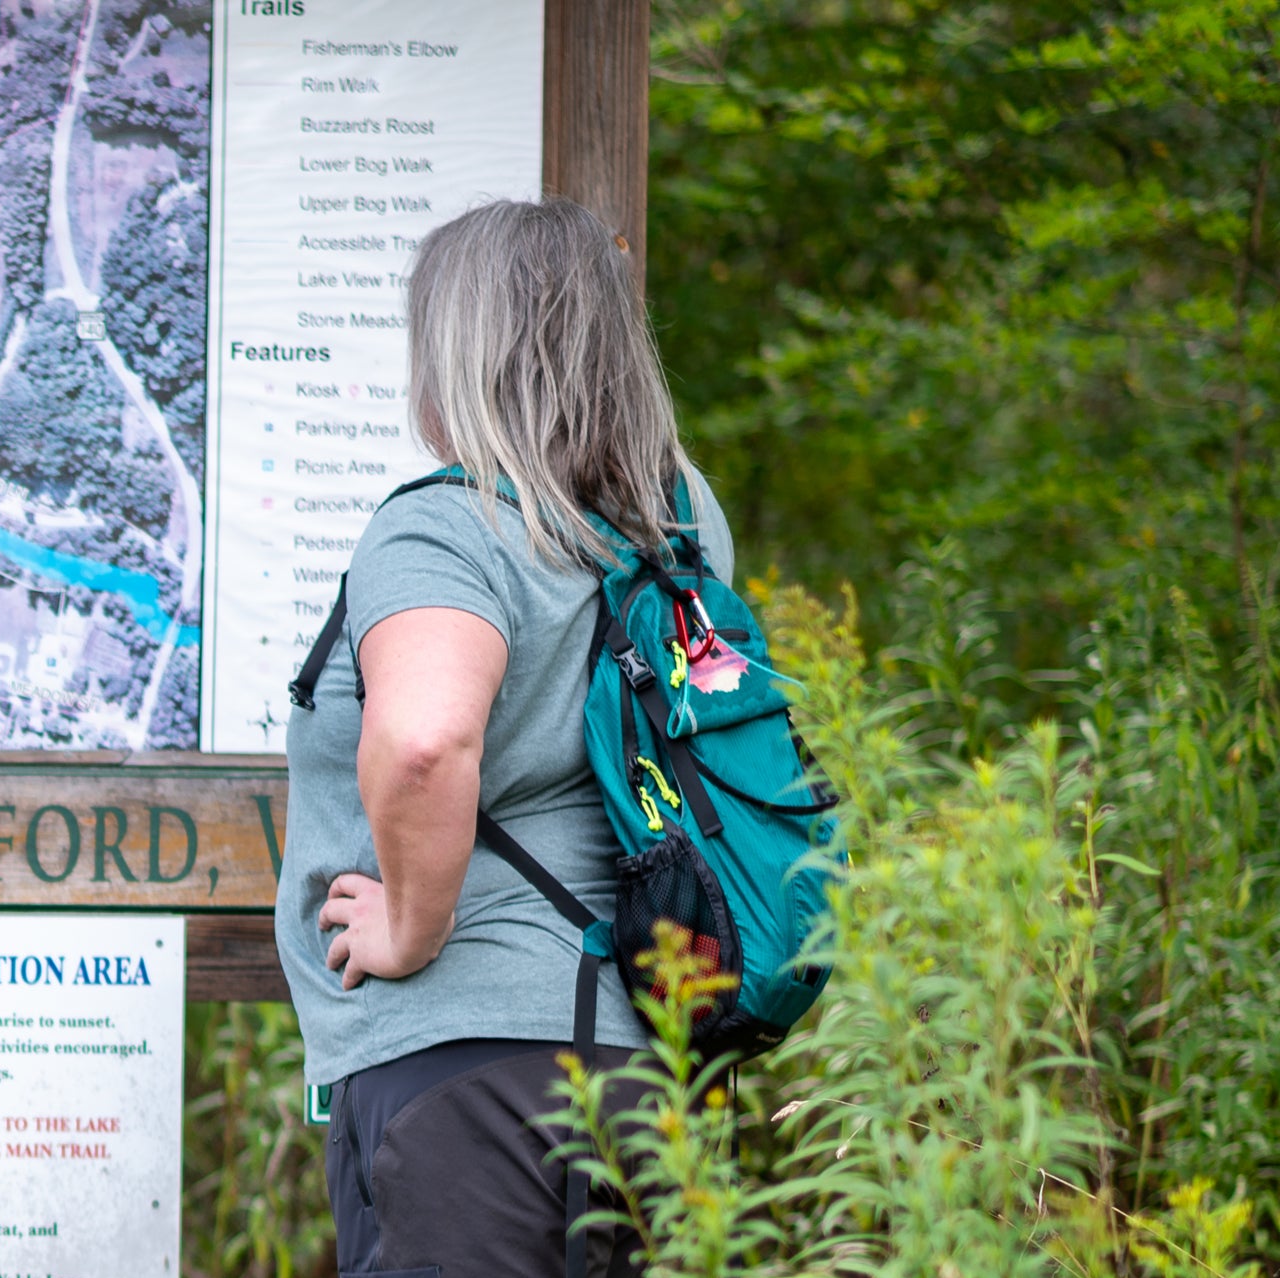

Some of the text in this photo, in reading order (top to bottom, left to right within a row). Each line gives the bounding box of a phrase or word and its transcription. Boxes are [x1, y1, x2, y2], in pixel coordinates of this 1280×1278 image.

[240, 0, 305, 16] Trails
[301, 40, 459, 58] Fisherman's Elbow
[301, 77, 380, 94] Rim Walk
[300, 117, 435, 134] Buzzard's Roost
[299, 156, 433, 176] Lower Bog Walk
[299, 196, 432, 216] Upper Bog Walk
[298, 234, 386, 251] Accessible
[297, 272, 338, 288] Lake
[342, 272, 383, 288] View
[297, 312, 345, 328] Stone
[230, 342, 331, 361] Features
[296, 382, 340, 398] Kiosk
[367, 384, 396, 399] You
[295, 420, 400, 440] Parking Area
[295, 459, 386, 475] Picnic Area
[294, 601, 323, 616] The
[72, 955, 151, 986] AREA
[40, 1014, 54, 1028] to
[58, 1015, 115, 1029] sunset.
[54, 1041, 153, 1056] encouraged.
[3, 1117, 28, 1132] TO
[32, 1117, 71, 1132] THE
[75, 1117, 120, 1133] LAKE
[6, 1143, 52, 1158] MAIN
[57, 1144, 111, 1160] TRAIL
[28, 1222, 58, 1236] and
